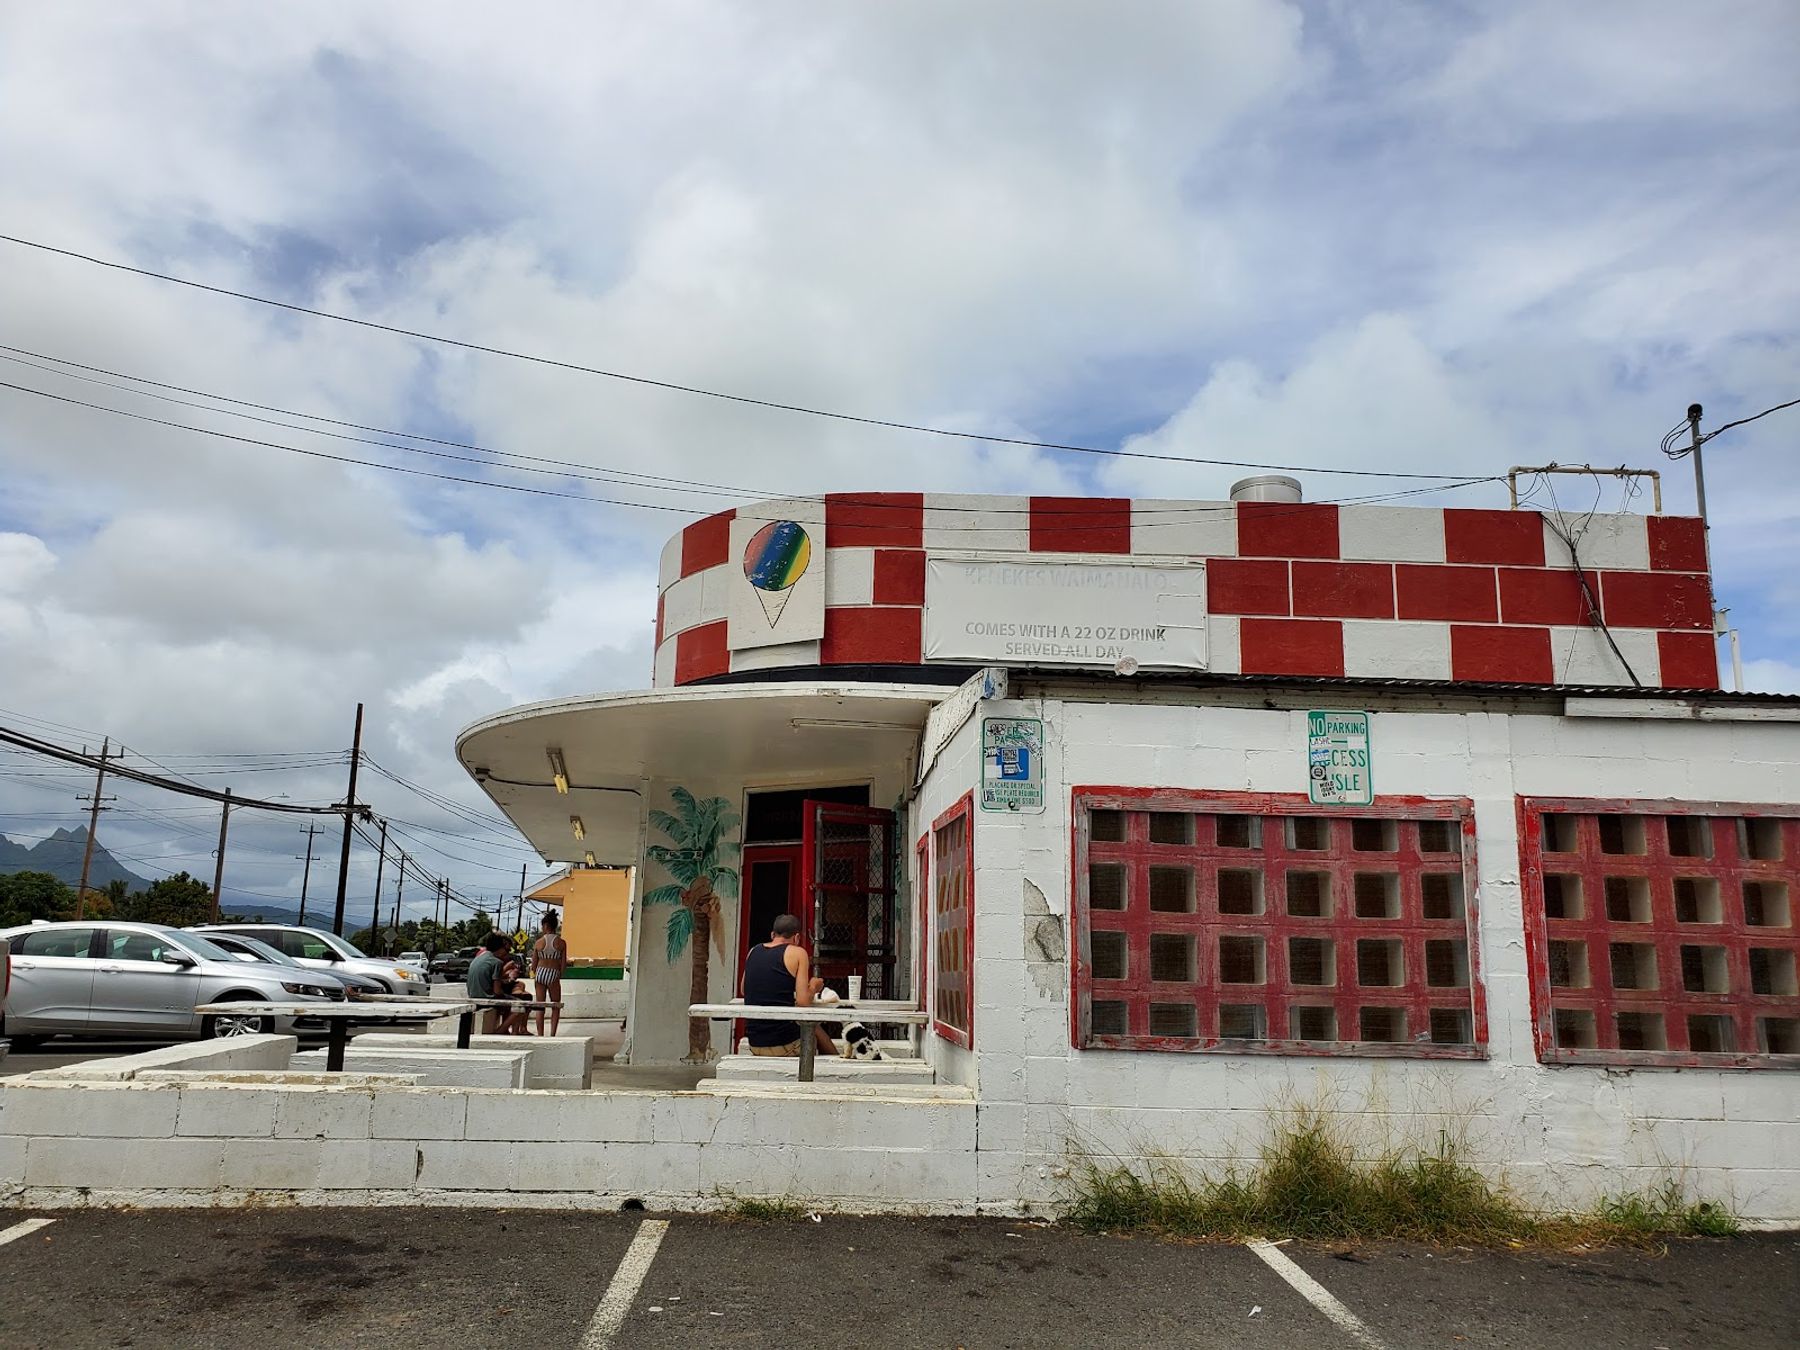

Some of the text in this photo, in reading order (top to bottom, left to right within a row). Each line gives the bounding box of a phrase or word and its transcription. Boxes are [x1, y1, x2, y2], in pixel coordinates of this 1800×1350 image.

[965, 622, 1166, 642] COMES WITH A 22 OZ DRINK
[1005, 642, 1125, 659] SERVED ALL DAY
[1308, 717, 1365, 736] NO PARKING
